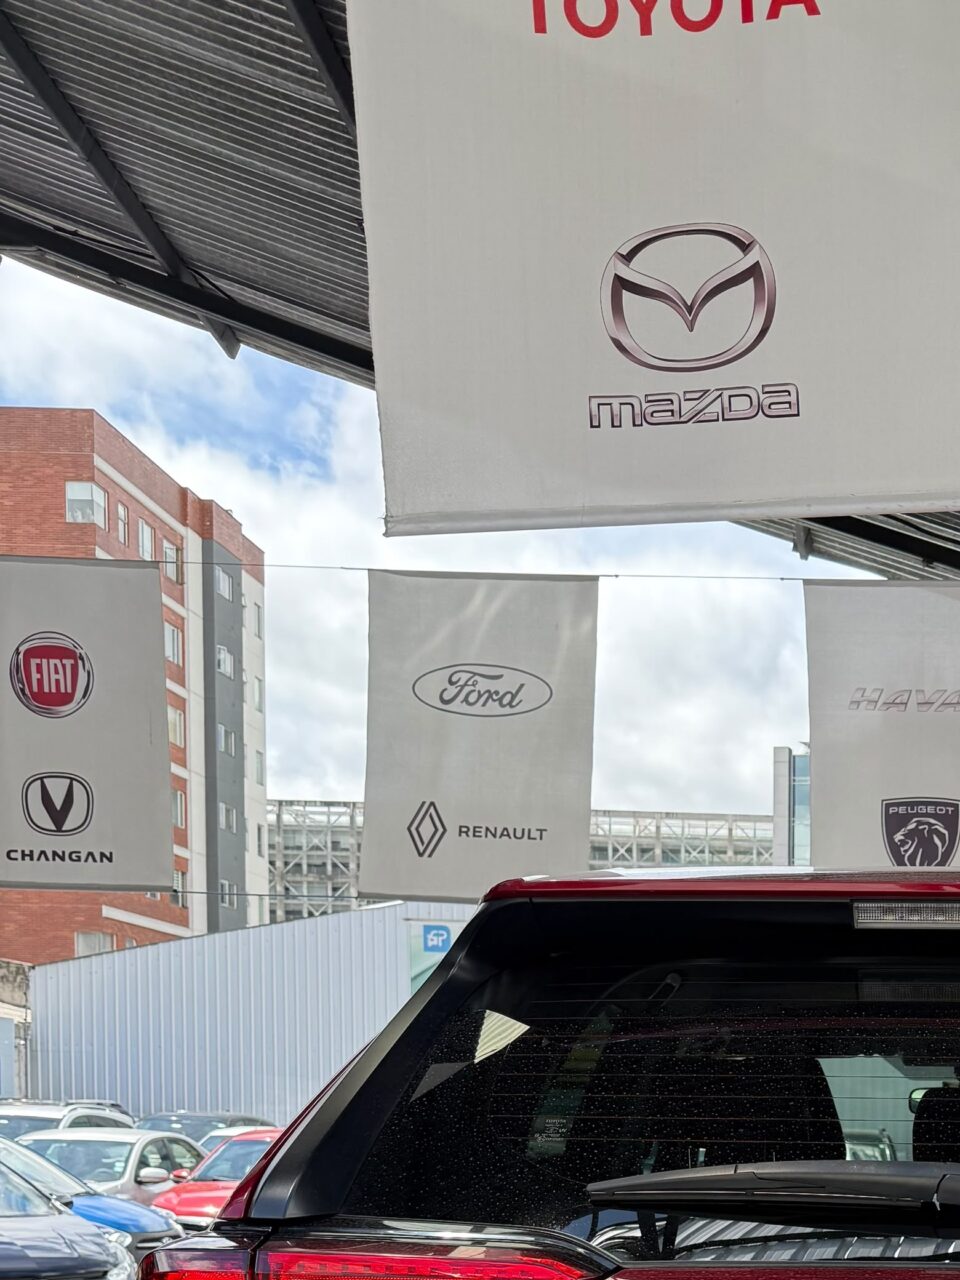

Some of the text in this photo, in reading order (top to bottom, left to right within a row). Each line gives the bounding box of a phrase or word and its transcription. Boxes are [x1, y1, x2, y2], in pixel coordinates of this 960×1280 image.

[30, 657, 75, 694] FIAT
[439, 669, 526, 709] Ford
[888, 805, 955, 815] PEUGEOT
[457, 824, 548, 841] RENAULT
[6, 849, 114, 864] CHANGAN
